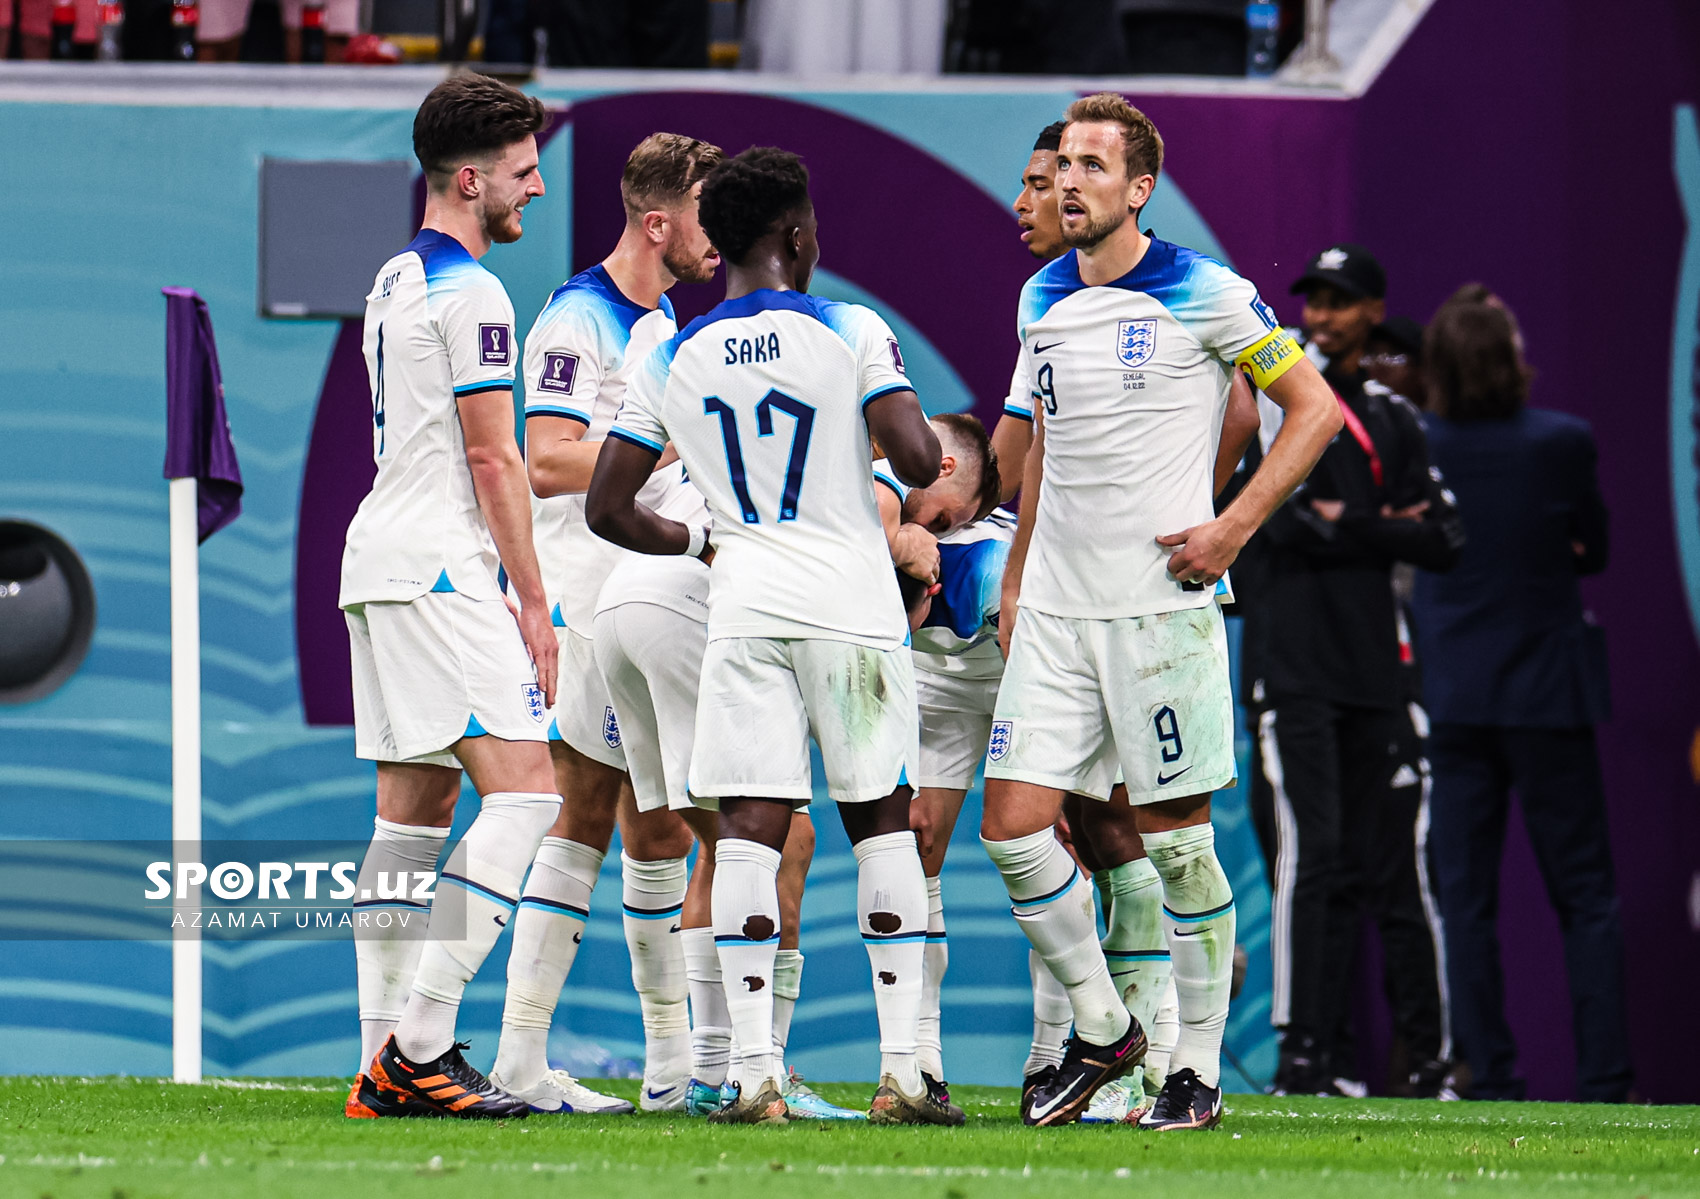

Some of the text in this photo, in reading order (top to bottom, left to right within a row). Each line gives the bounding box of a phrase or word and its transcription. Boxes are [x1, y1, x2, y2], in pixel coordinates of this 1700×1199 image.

[724, 332, 781, 365] SAKA
[1259, 345, 1293, 374] FOR ALL
[1038, 361, 1058, 416] 9
[702, 387, 817, 525] 17
[1153, 704, 1184, 764] 9
